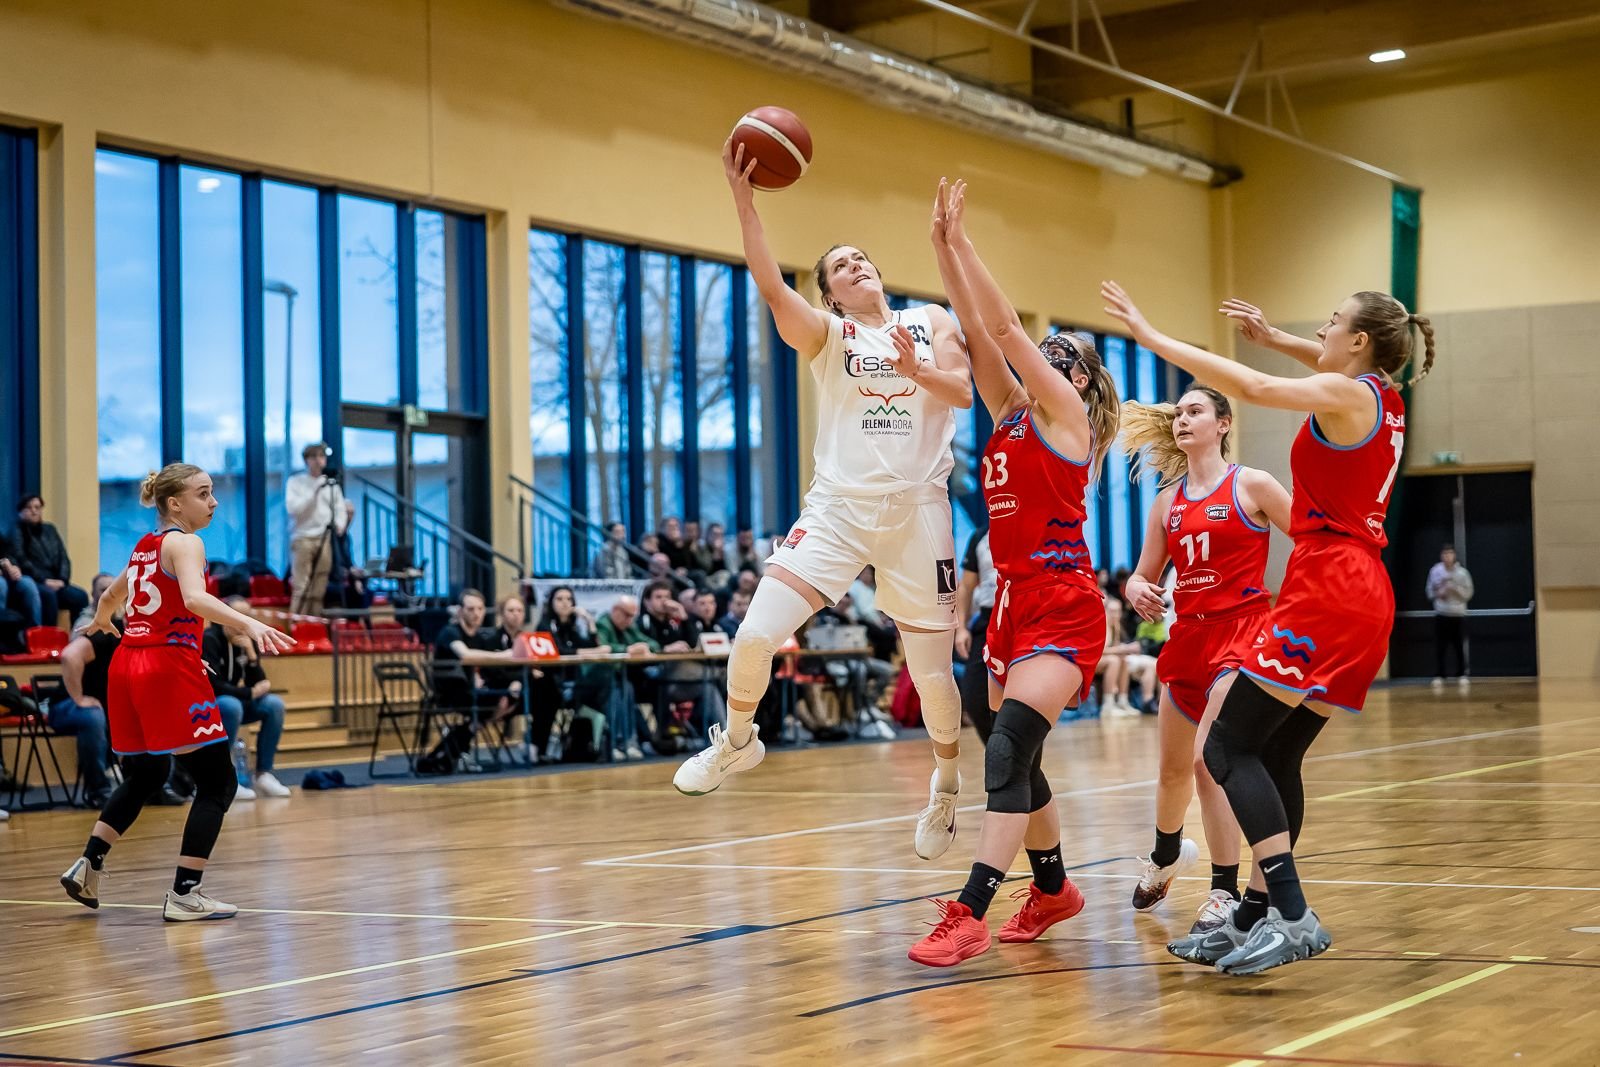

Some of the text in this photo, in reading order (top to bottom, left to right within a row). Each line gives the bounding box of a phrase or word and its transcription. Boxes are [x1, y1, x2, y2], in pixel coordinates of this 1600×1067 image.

[862, 419, 891, 429] JELENIA
[983, 452, 1008, 489] 23
[1179, 531, 1209, 566] 11
[126, 561, 162, 617] 15
